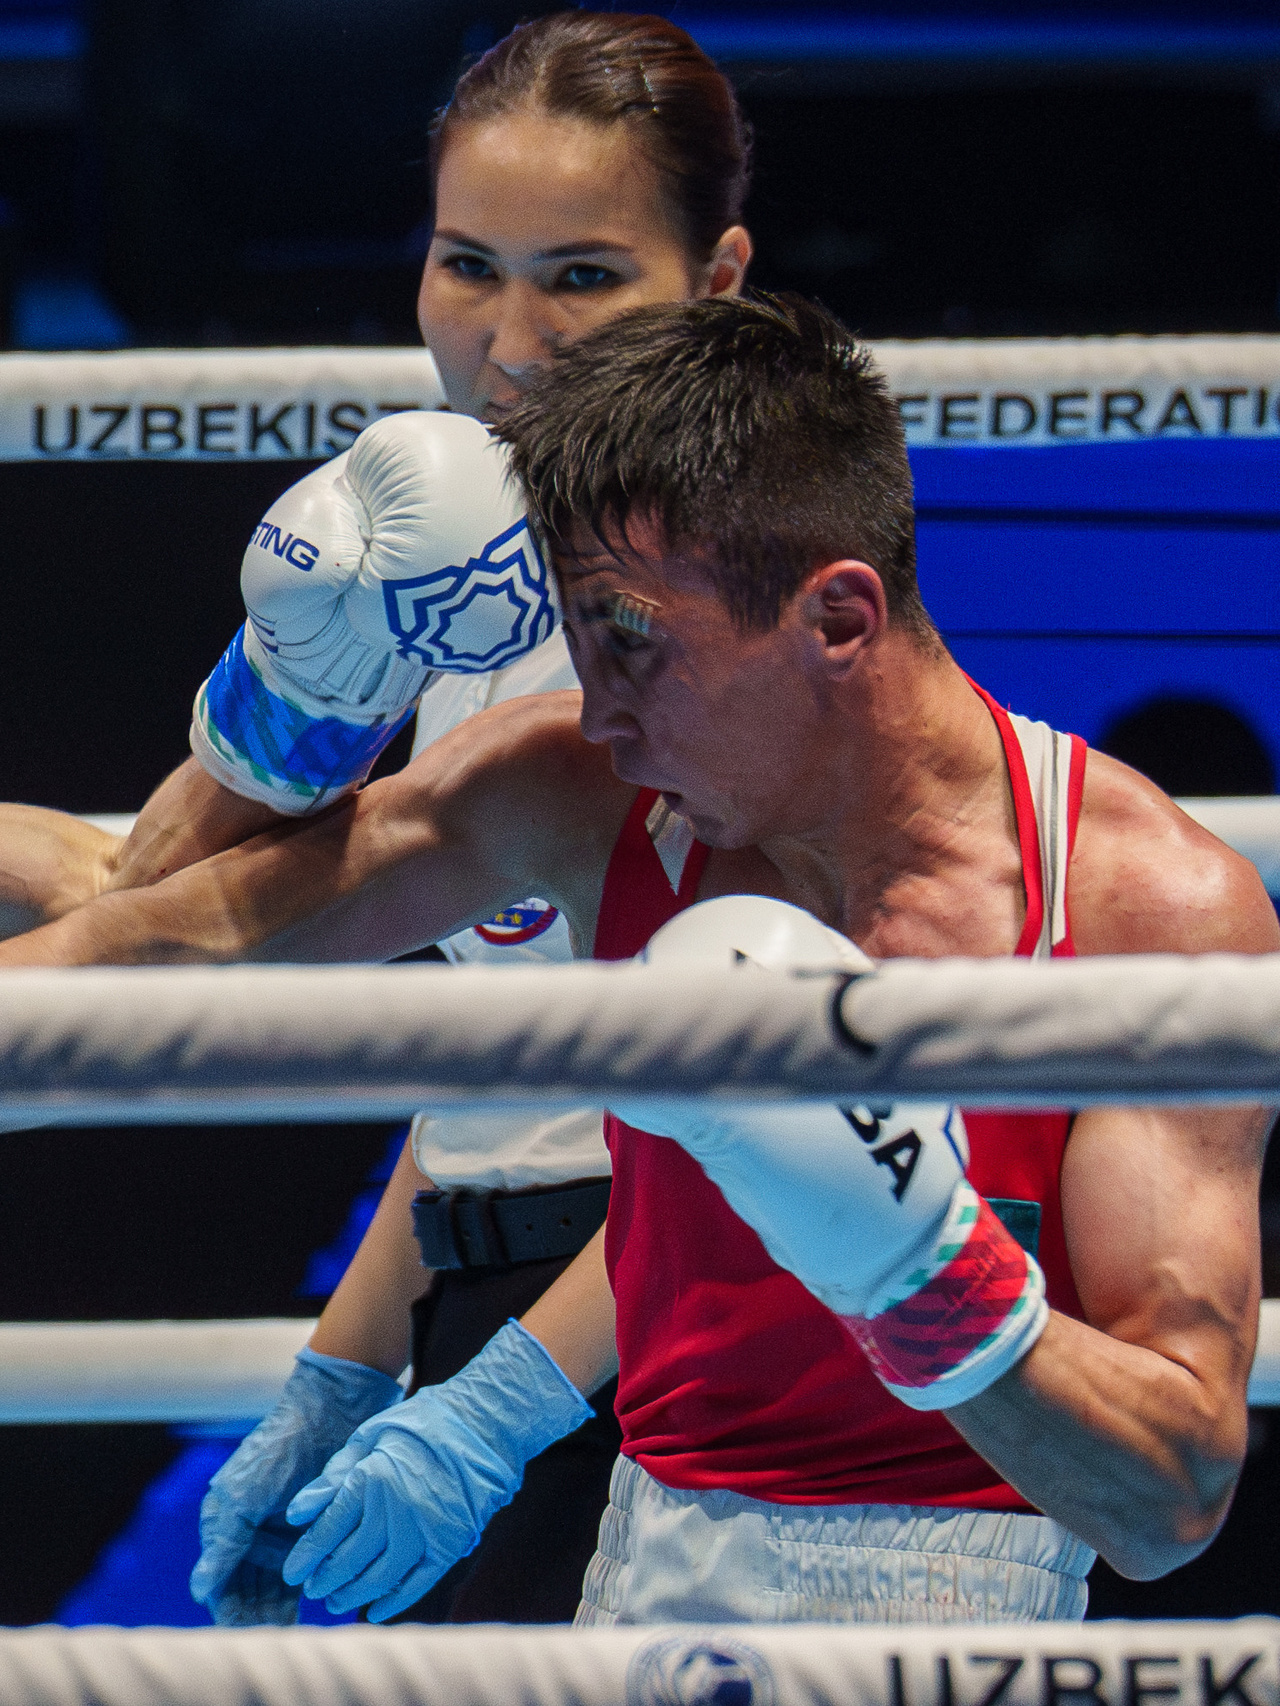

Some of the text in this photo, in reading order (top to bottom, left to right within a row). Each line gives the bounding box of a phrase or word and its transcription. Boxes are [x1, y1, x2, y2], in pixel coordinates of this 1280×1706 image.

[32, 402, 453, 453] UZBEKIS
[894, 388, 1280, 441] FEDERATI
[249, 521, 320, 572] TING
